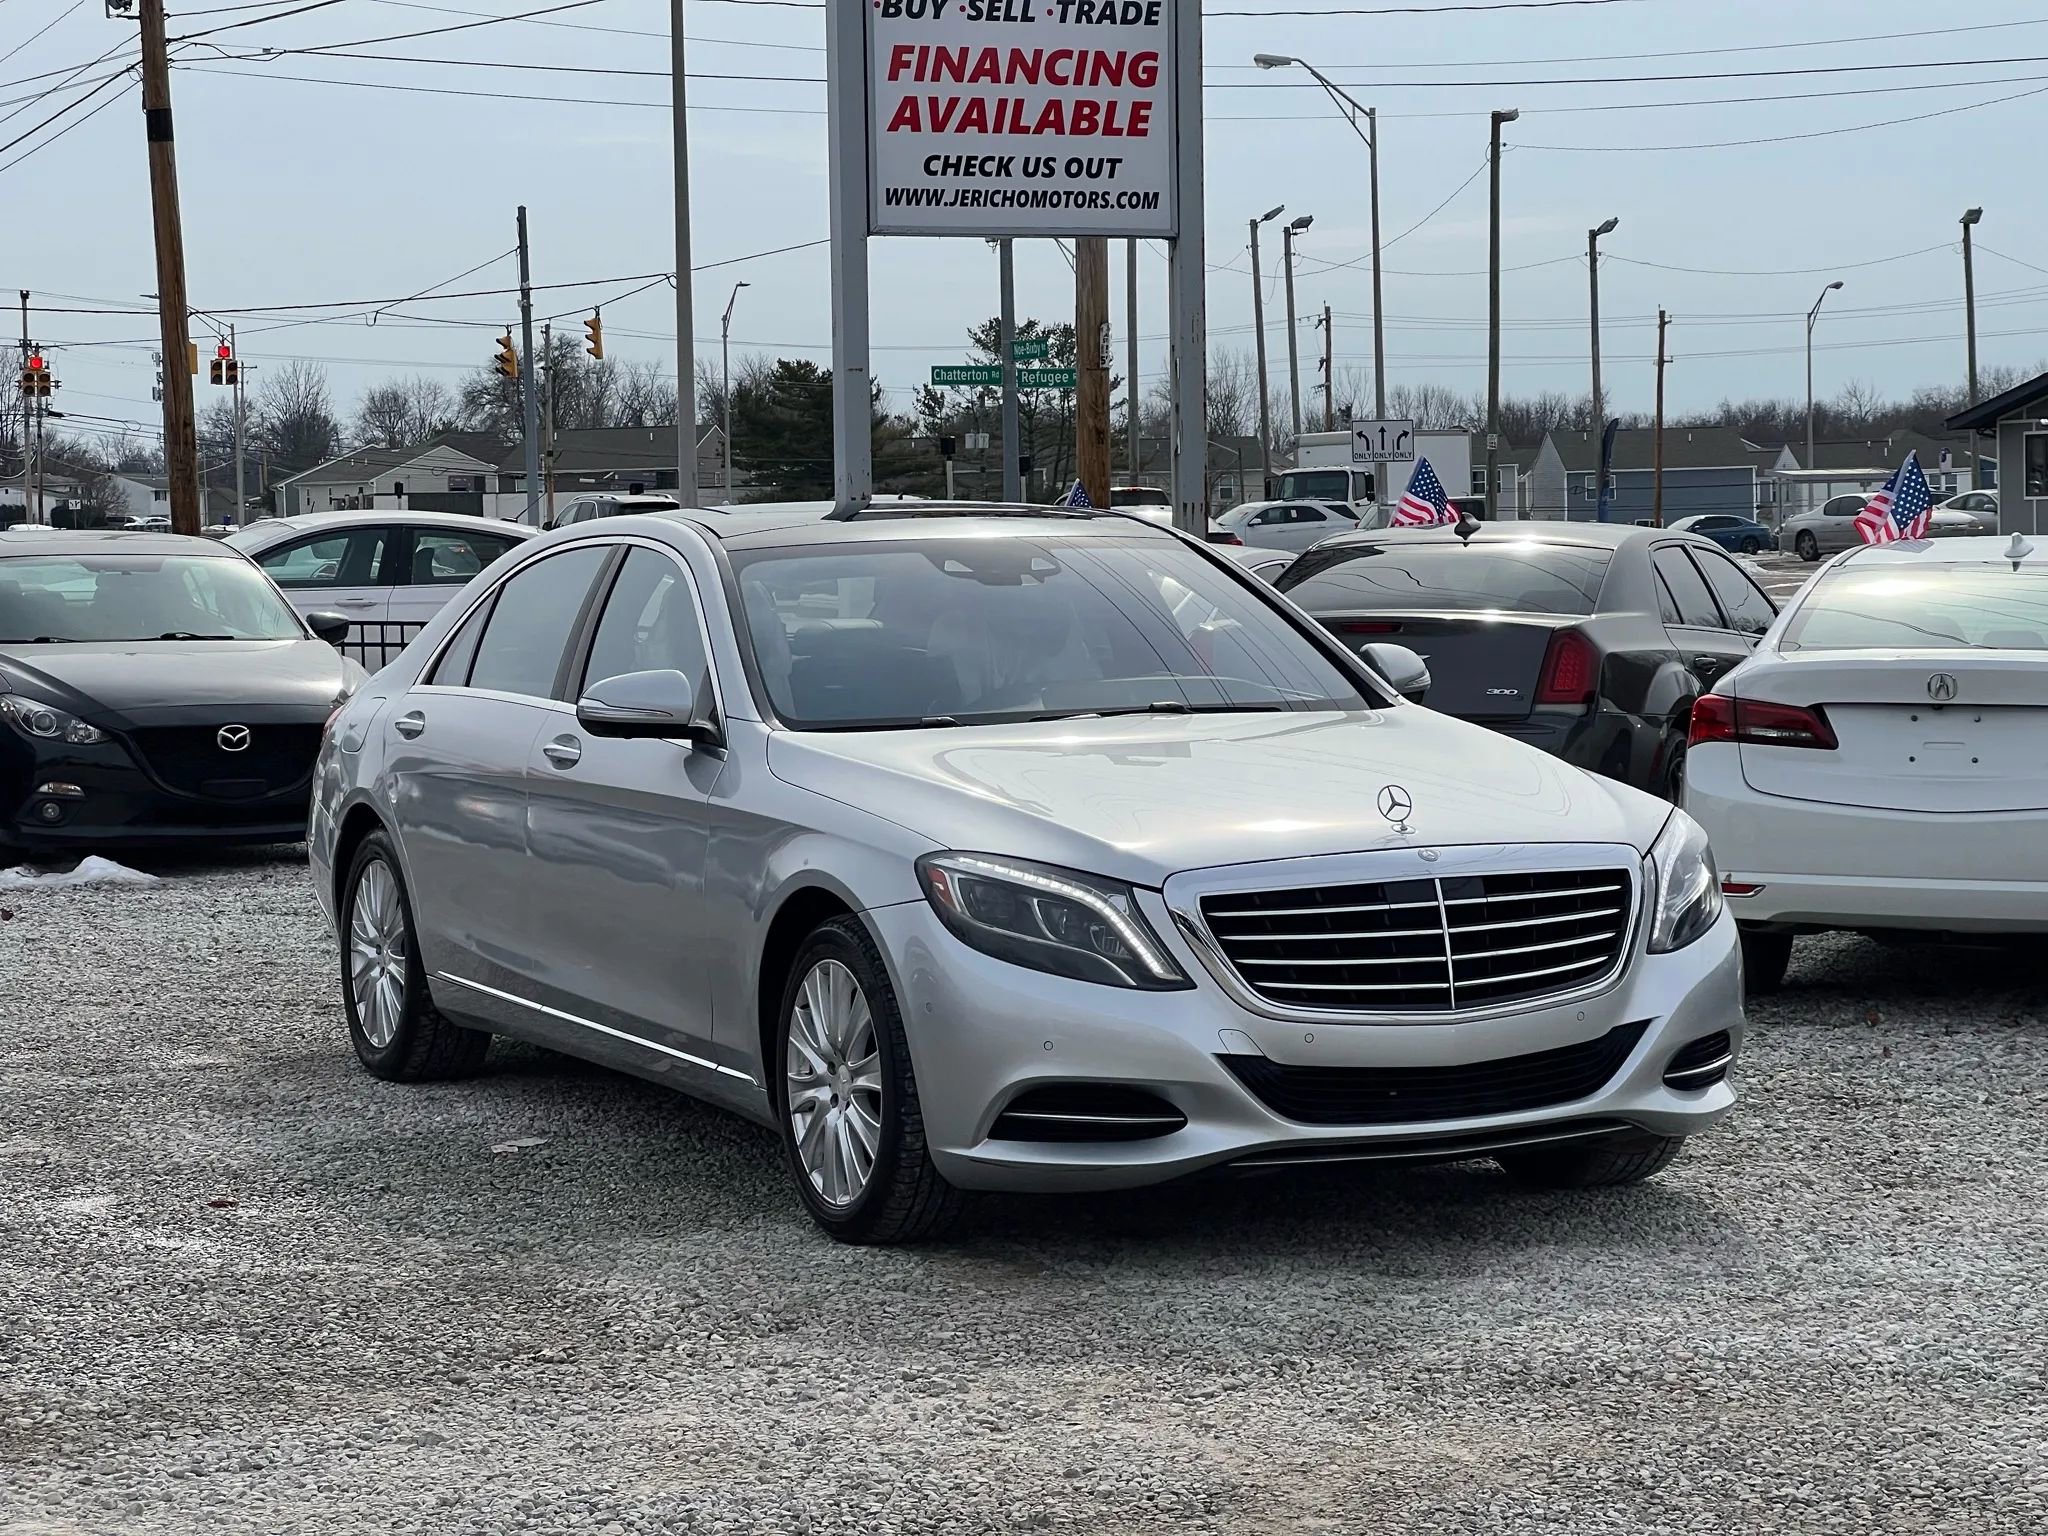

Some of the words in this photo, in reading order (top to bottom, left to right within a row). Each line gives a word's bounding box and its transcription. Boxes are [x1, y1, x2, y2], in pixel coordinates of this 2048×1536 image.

[881, 0, 948, 19] BUY
[967, 0, 1036, 22] SELL
[1056, 0, 1161, 25] TRADE
[887, 44, 1159, 88] FINANCING
[886, 95, 1152, 137] AVAILABLE
[923, 154, 1015, 178] CHECK
[1021, 156, 1056, 179] US
[1064, 157, 1123, 179] OUT
[885, 187, 1160, 210] WWW.JERICHOMOTORS.COM
[933, 368, 988, 381] Chatterton
[991, 370, 1000, 379] Rd
[1021, 371, 1069, 387] Refugee
[1354, 452, 1372, 460] ONLY
[1394, 451, 1412, 459] ONLY
